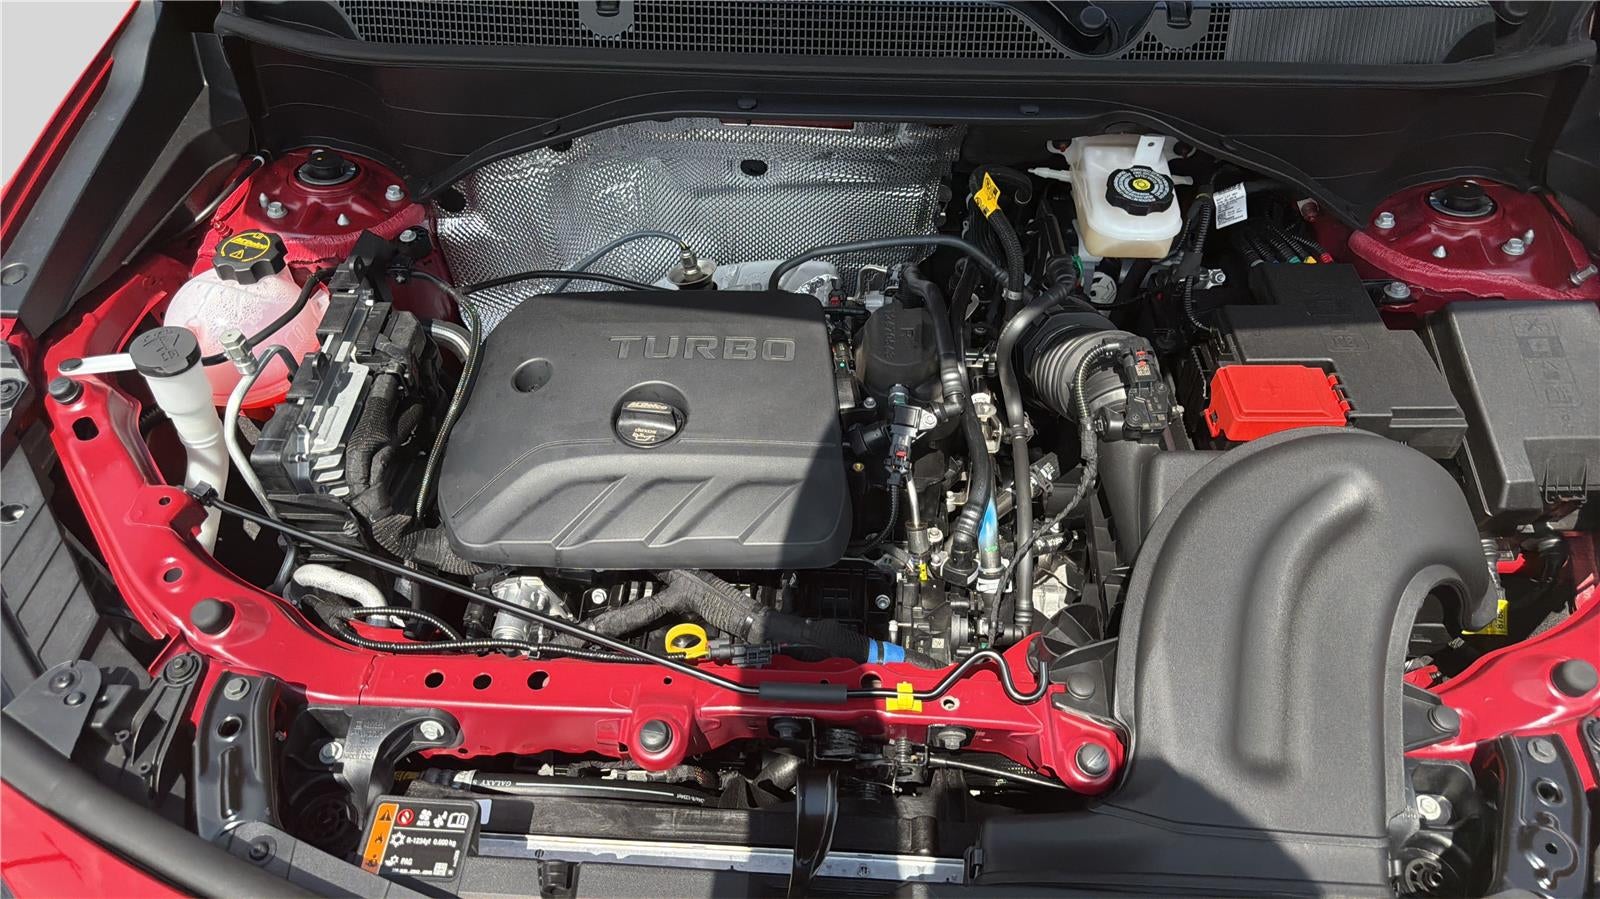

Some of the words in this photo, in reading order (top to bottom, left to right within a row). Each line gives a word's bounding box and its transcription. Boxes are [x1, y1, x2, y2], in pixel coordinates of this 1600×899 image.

[609, 335, 796, 361] TURBO
[627, 401, 668, 410] ACDelco
[479, 779, 512, 787] GALAXY
[406, 836, 431, 846] R-1234yf
[400, 857, 413, 866] PAG
